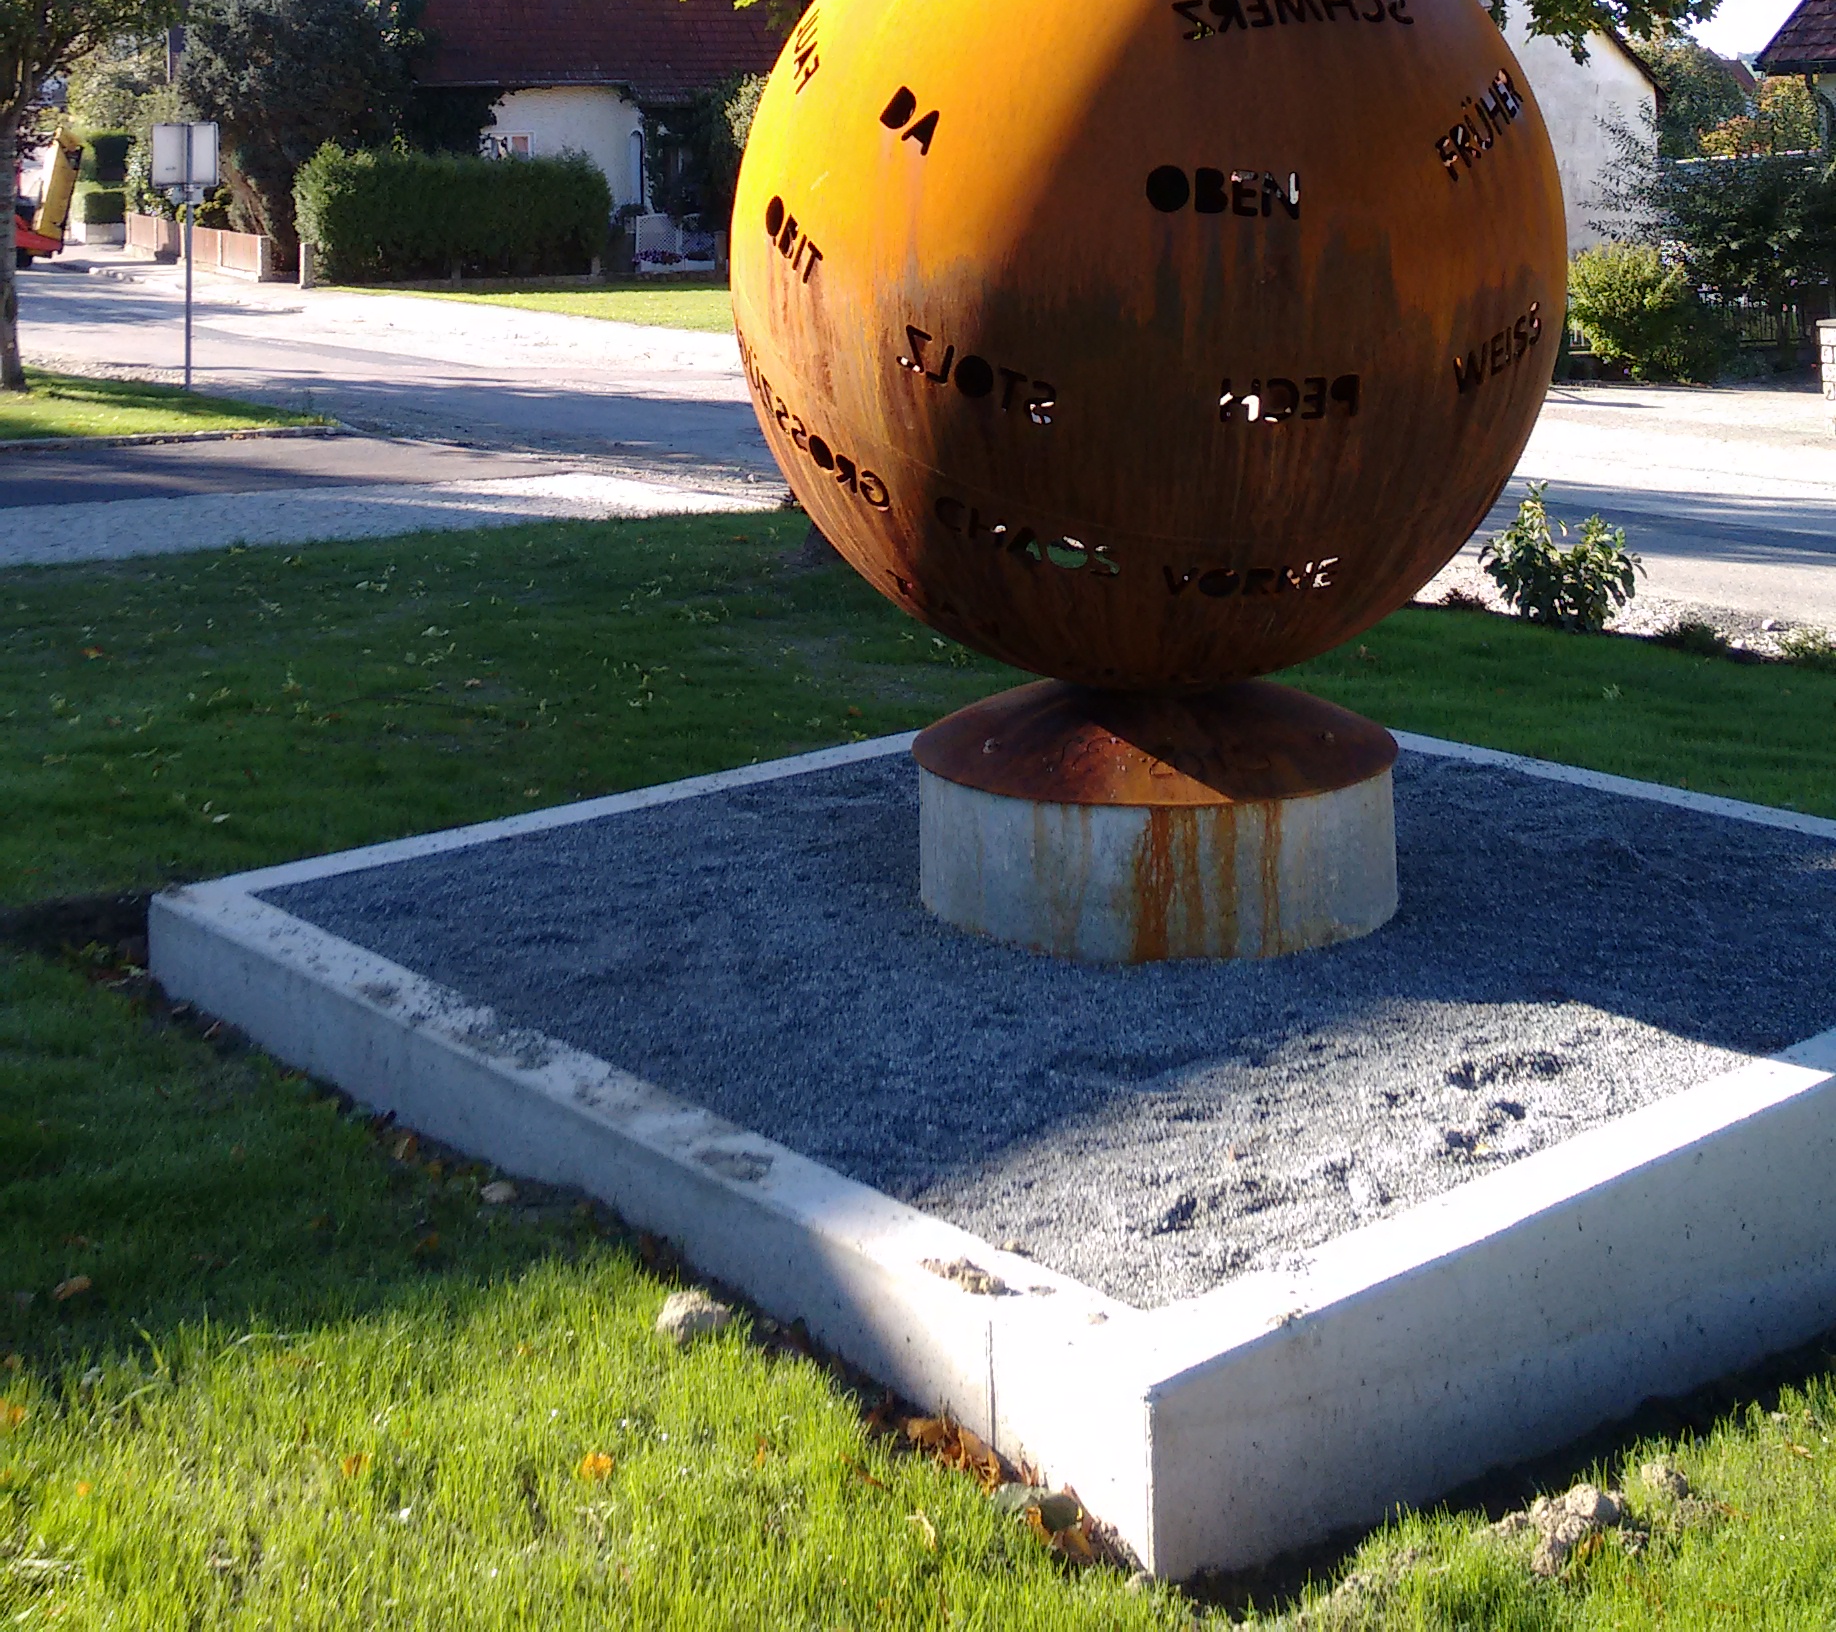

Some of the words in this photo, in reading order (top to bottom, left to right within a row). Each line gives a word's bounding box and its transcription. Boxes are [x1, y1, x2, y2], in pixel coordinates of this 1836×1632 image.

[879, 85, 940, 156] DA
[1435, 68, 1523, 182] FRÜHER
[1145, 165, 1300, 220] OBEN
[1453, 301, 1542, 394] WEISS
[934, 496, 1120, 578] CHAOS
[1163, 556, 1340, 596] VORNE
